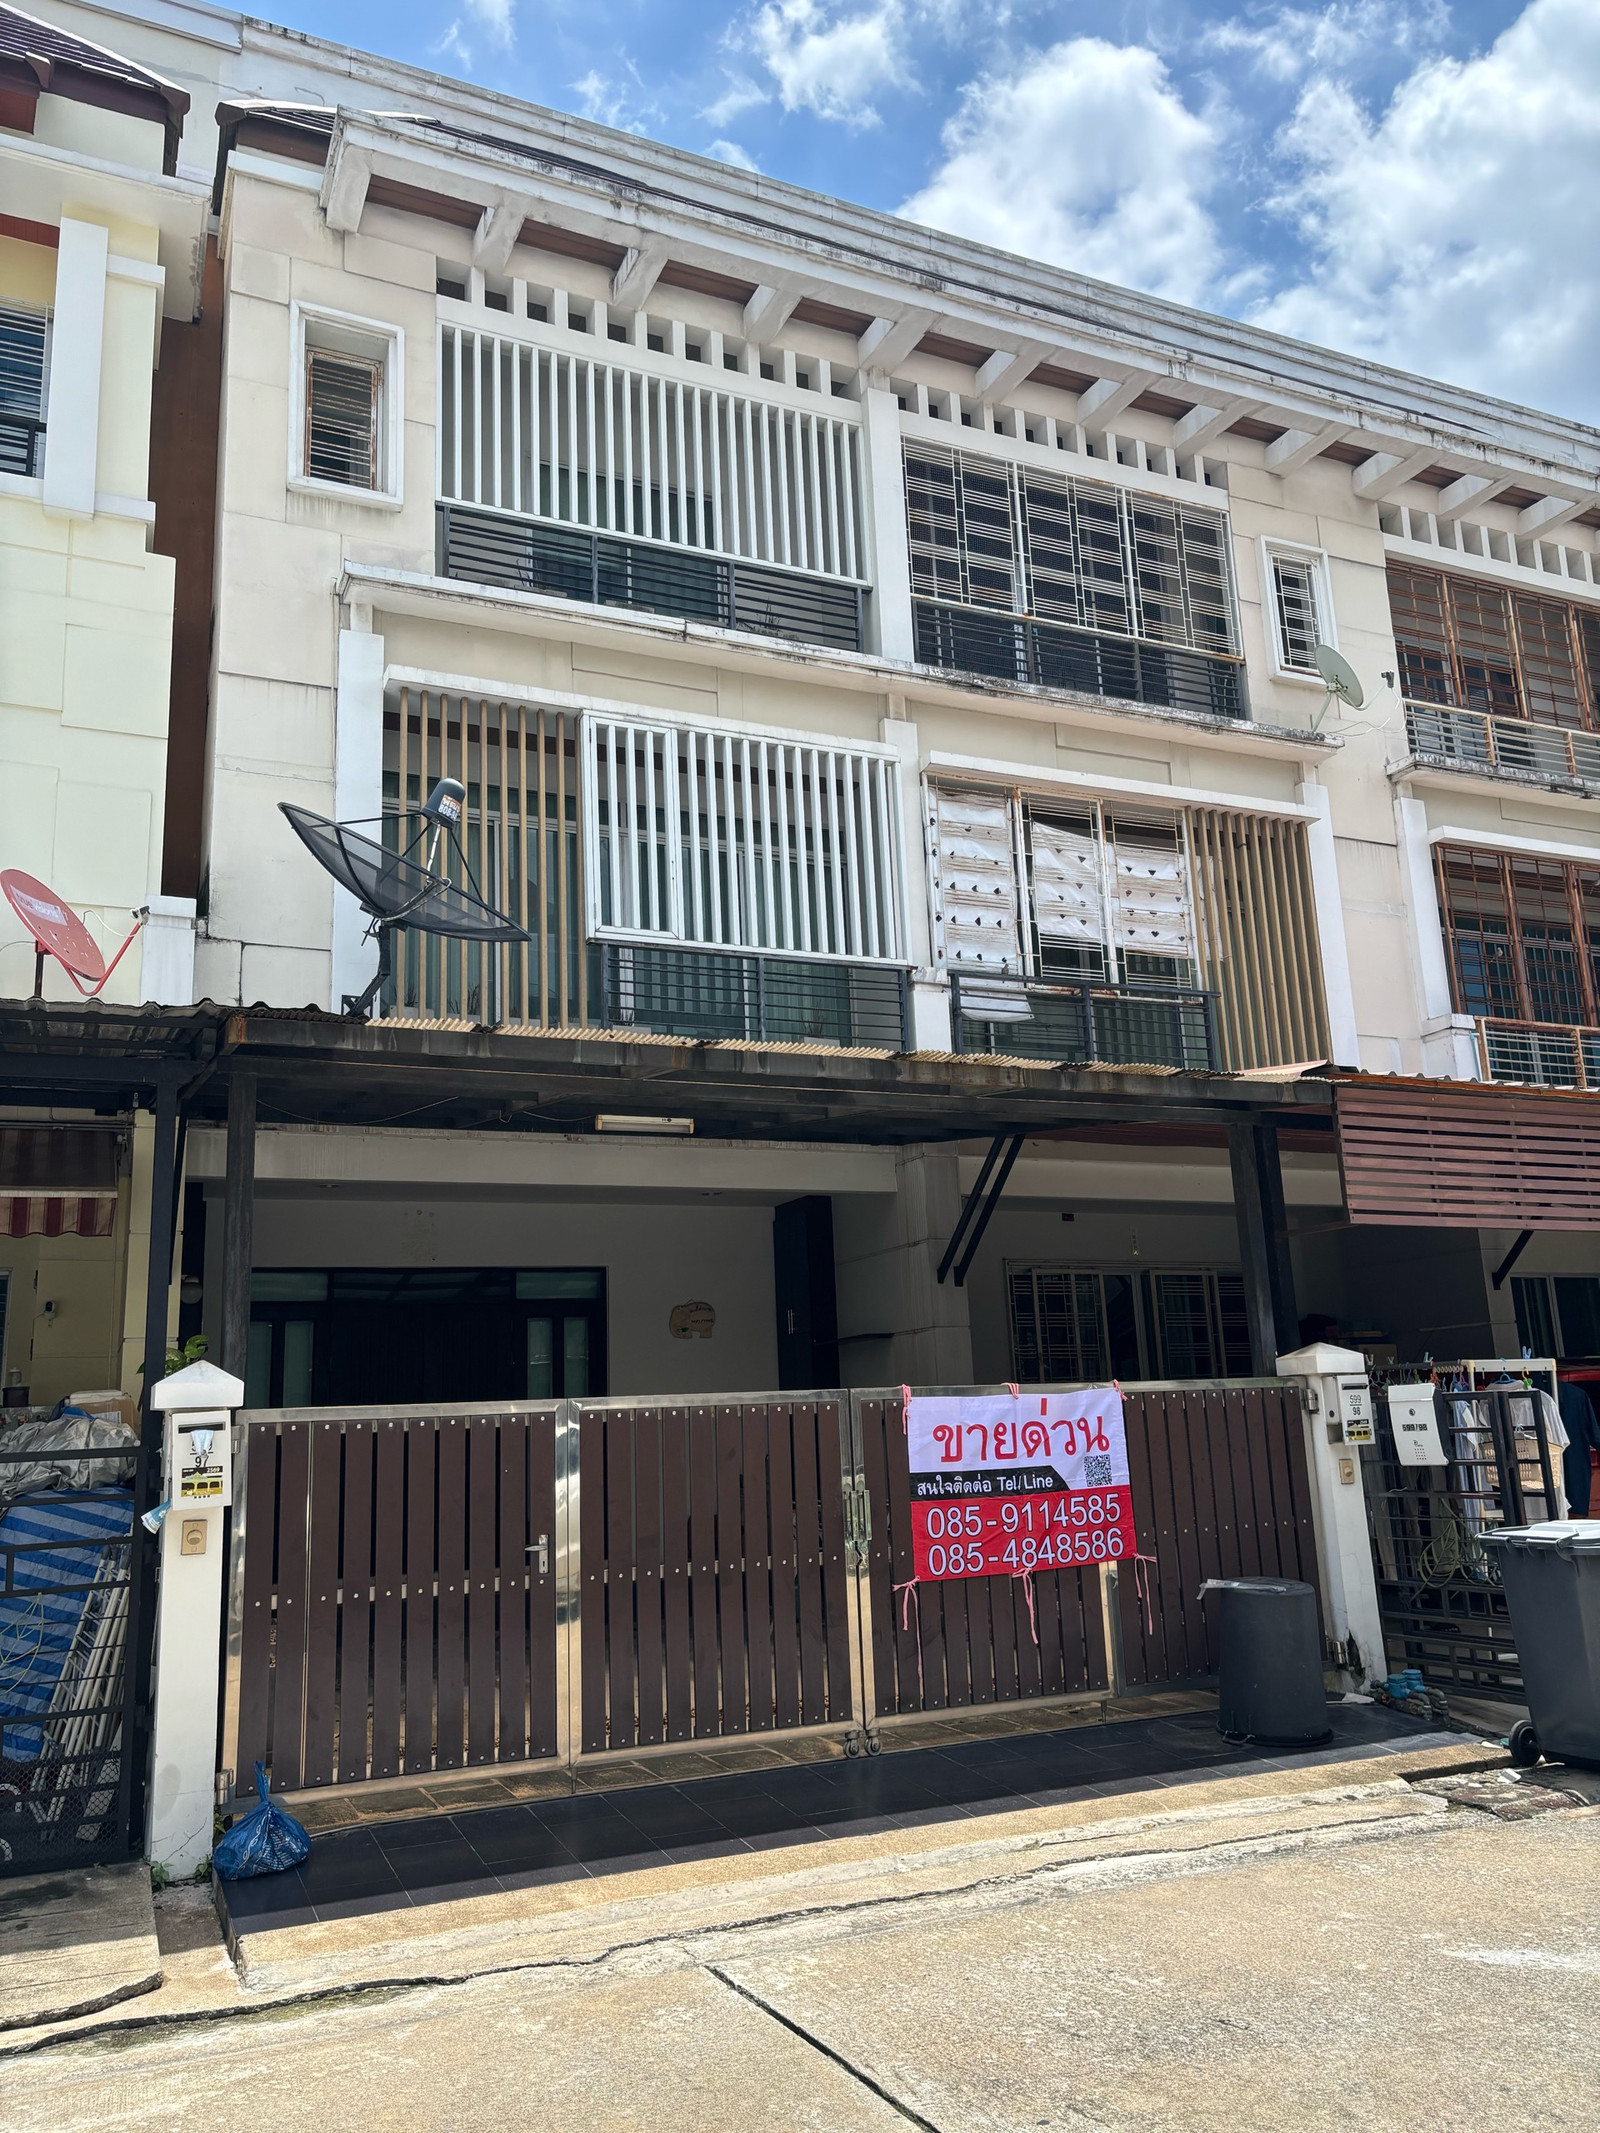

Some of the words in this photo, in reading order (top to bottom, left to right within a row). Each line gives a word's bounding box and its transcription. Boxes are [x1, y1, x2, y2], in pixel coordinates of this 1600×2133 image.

[1350, 1395, 1362, 1404] 599
[1353, 1407, 1362, 1416] 98
[932, 1397, 1110, 1463] ขายด่วน
[195, 1455, 209, 1468] 97
[917, 1474, 992, 1496] สนใจติดต่อ
[926, 1493, 1121, 1540] 085-9114585
[928, 1527, 1124, 1576] 085-4848586
